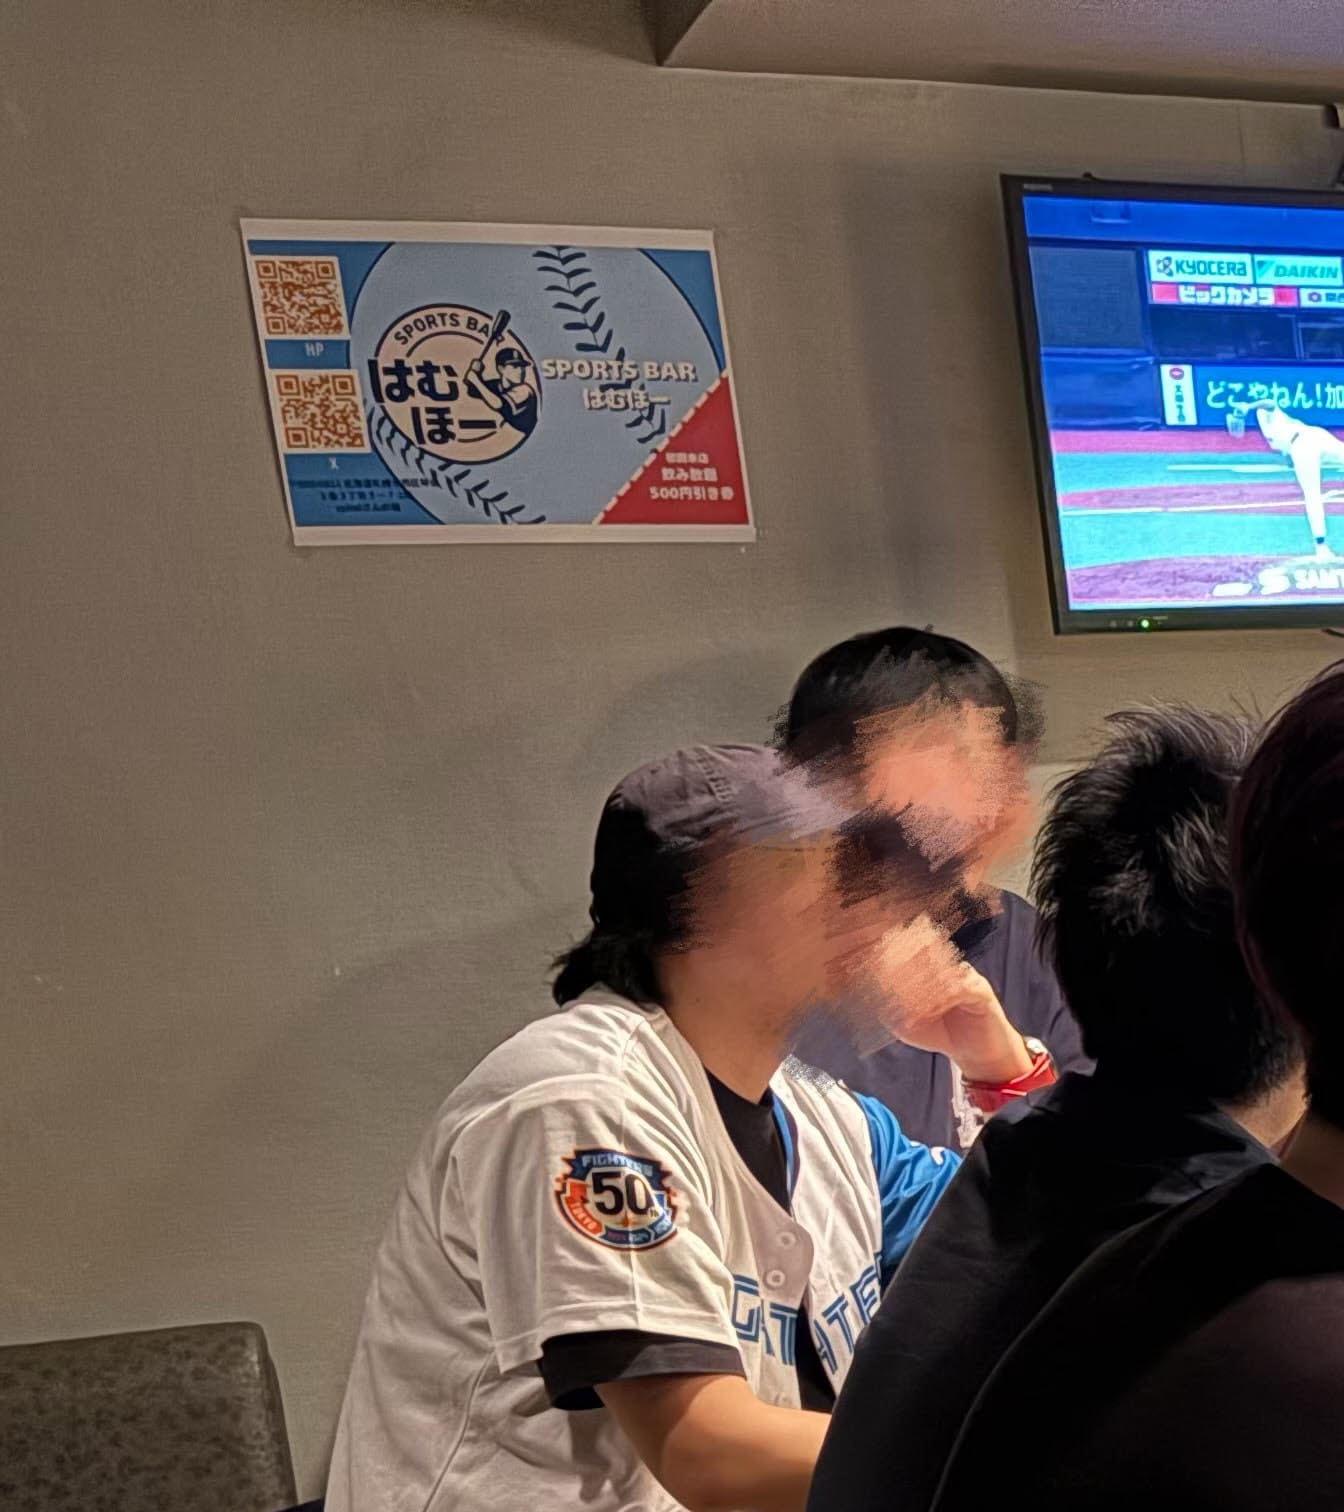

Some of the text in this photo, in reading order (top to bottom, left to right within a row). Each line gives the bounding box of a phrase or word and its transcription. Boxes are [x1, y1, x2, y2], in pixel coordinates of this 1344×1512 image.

[1175, 259, 1248, 277] KYOCERA
[1273, 264, 1339, 279] DAIKIN
[394, 312, 461, 345] SPORTS
[369, 358, 460, 404] はむ
[541, 359, 699, 383] SPORTS BAR
[583, 387, 671, 411] はむほー
[411, 406, 497, 445] ほー
[591, 1171, 656, 1216] 50
